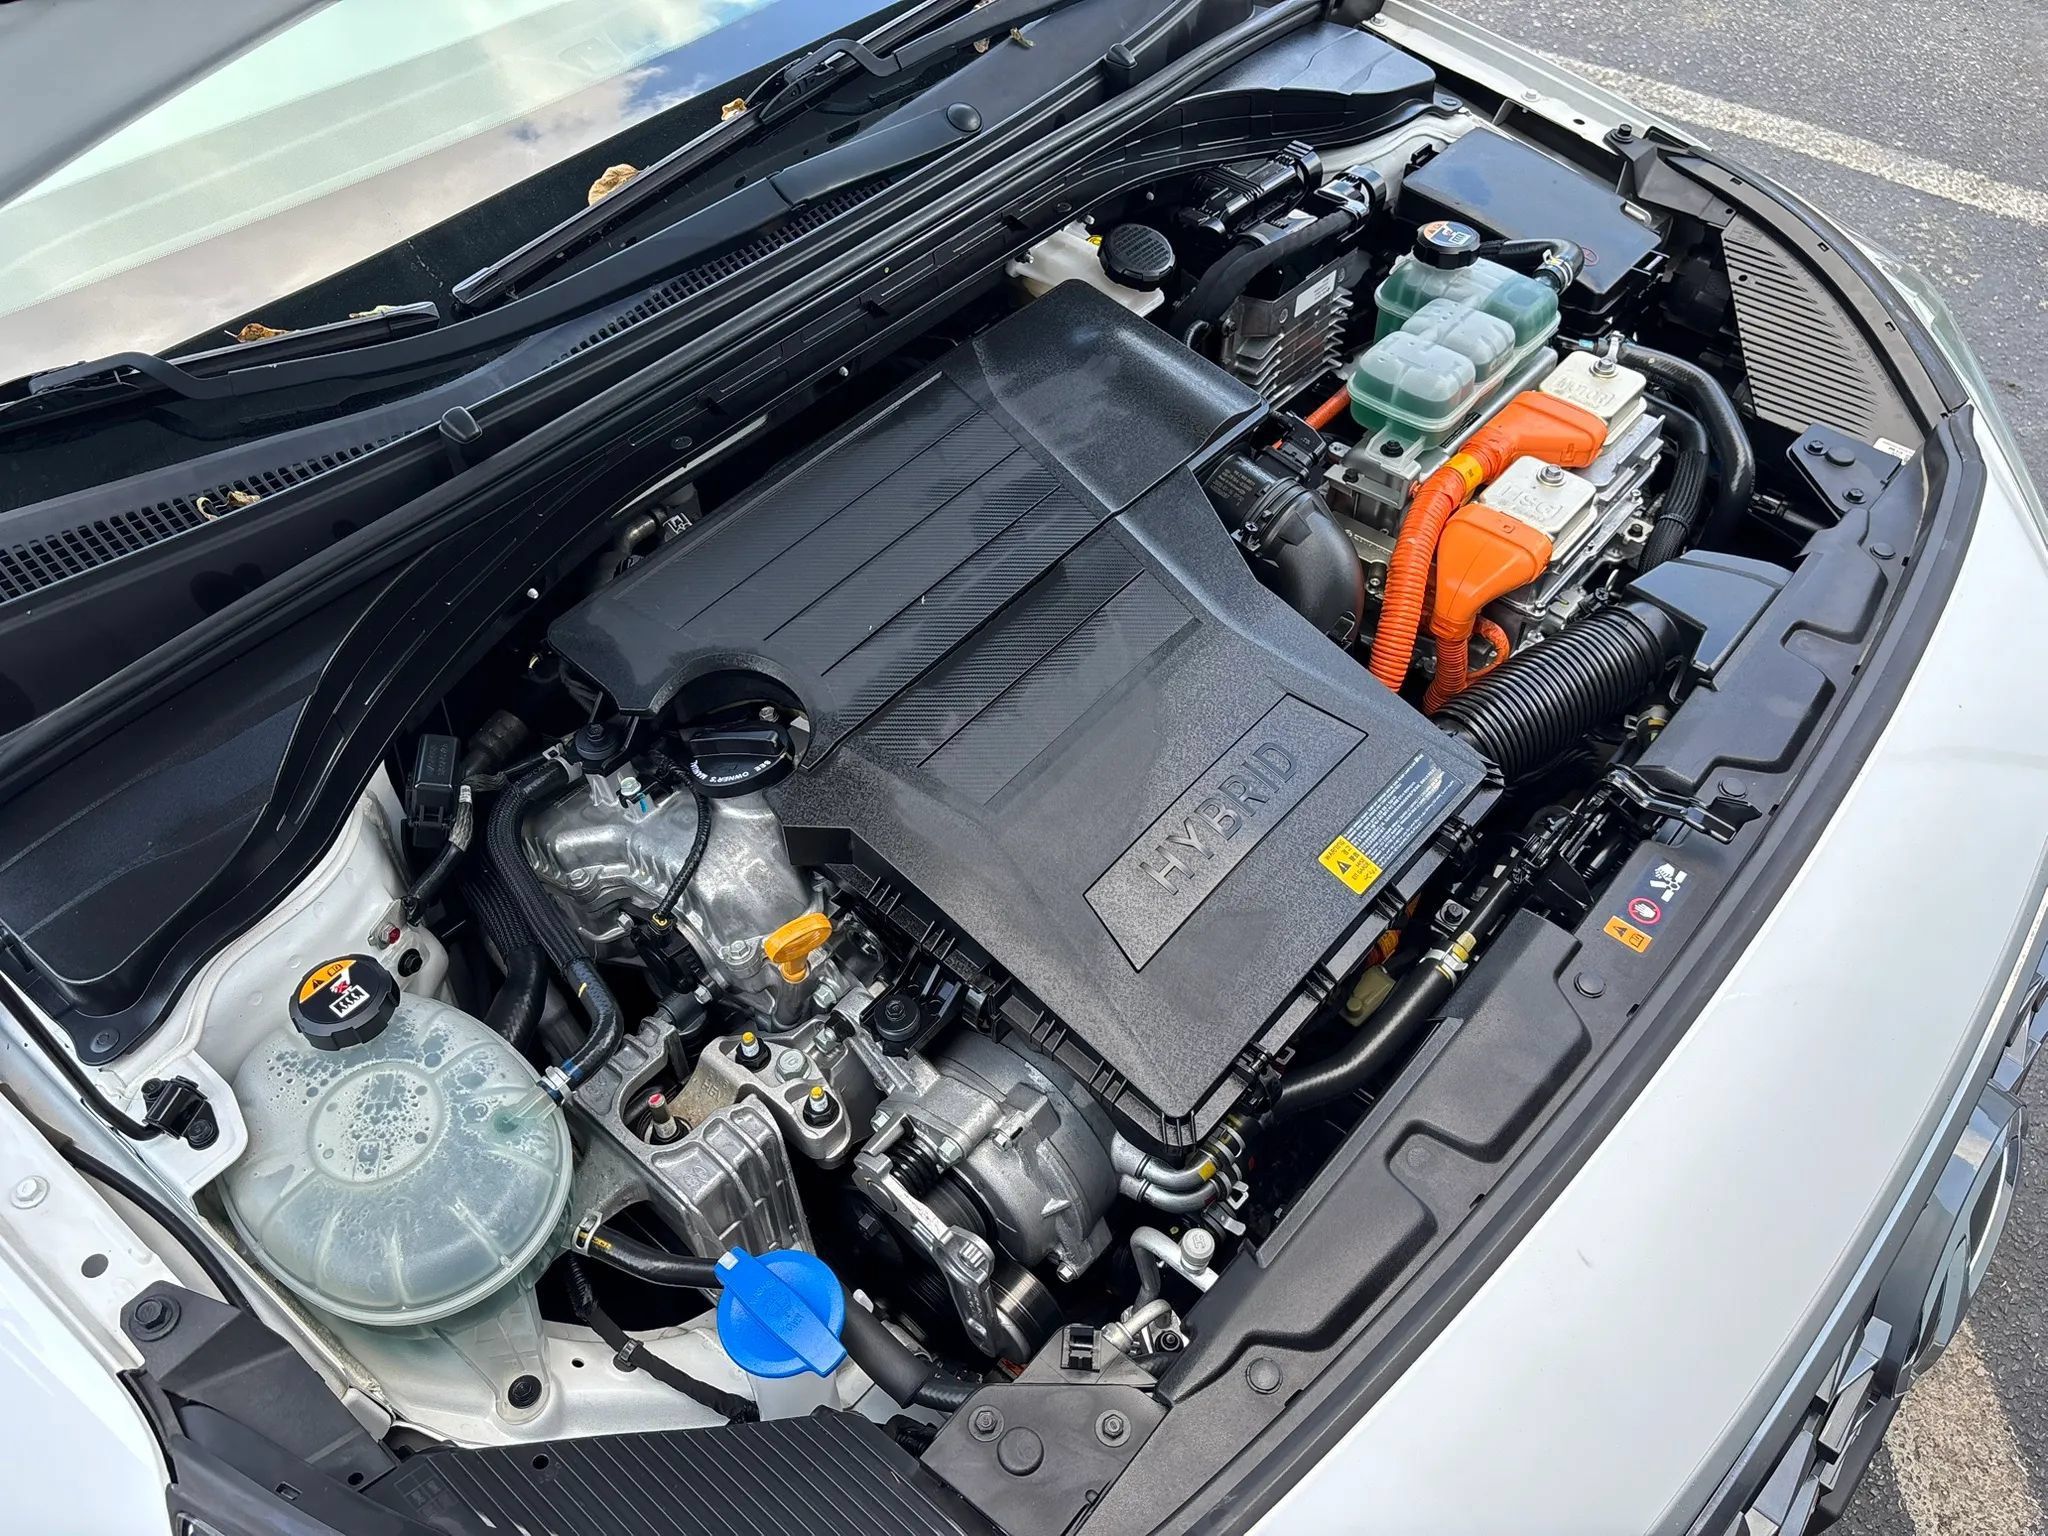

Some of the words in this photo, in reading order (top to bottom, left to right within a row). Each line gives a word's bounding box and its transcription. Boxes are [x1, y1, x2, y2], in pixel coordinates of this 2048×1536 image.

[753, 760, 772, 772] SEE
[709, 771, 750, 783] OWNER'S
[1139, 742, 1297, 896] HYBRID
